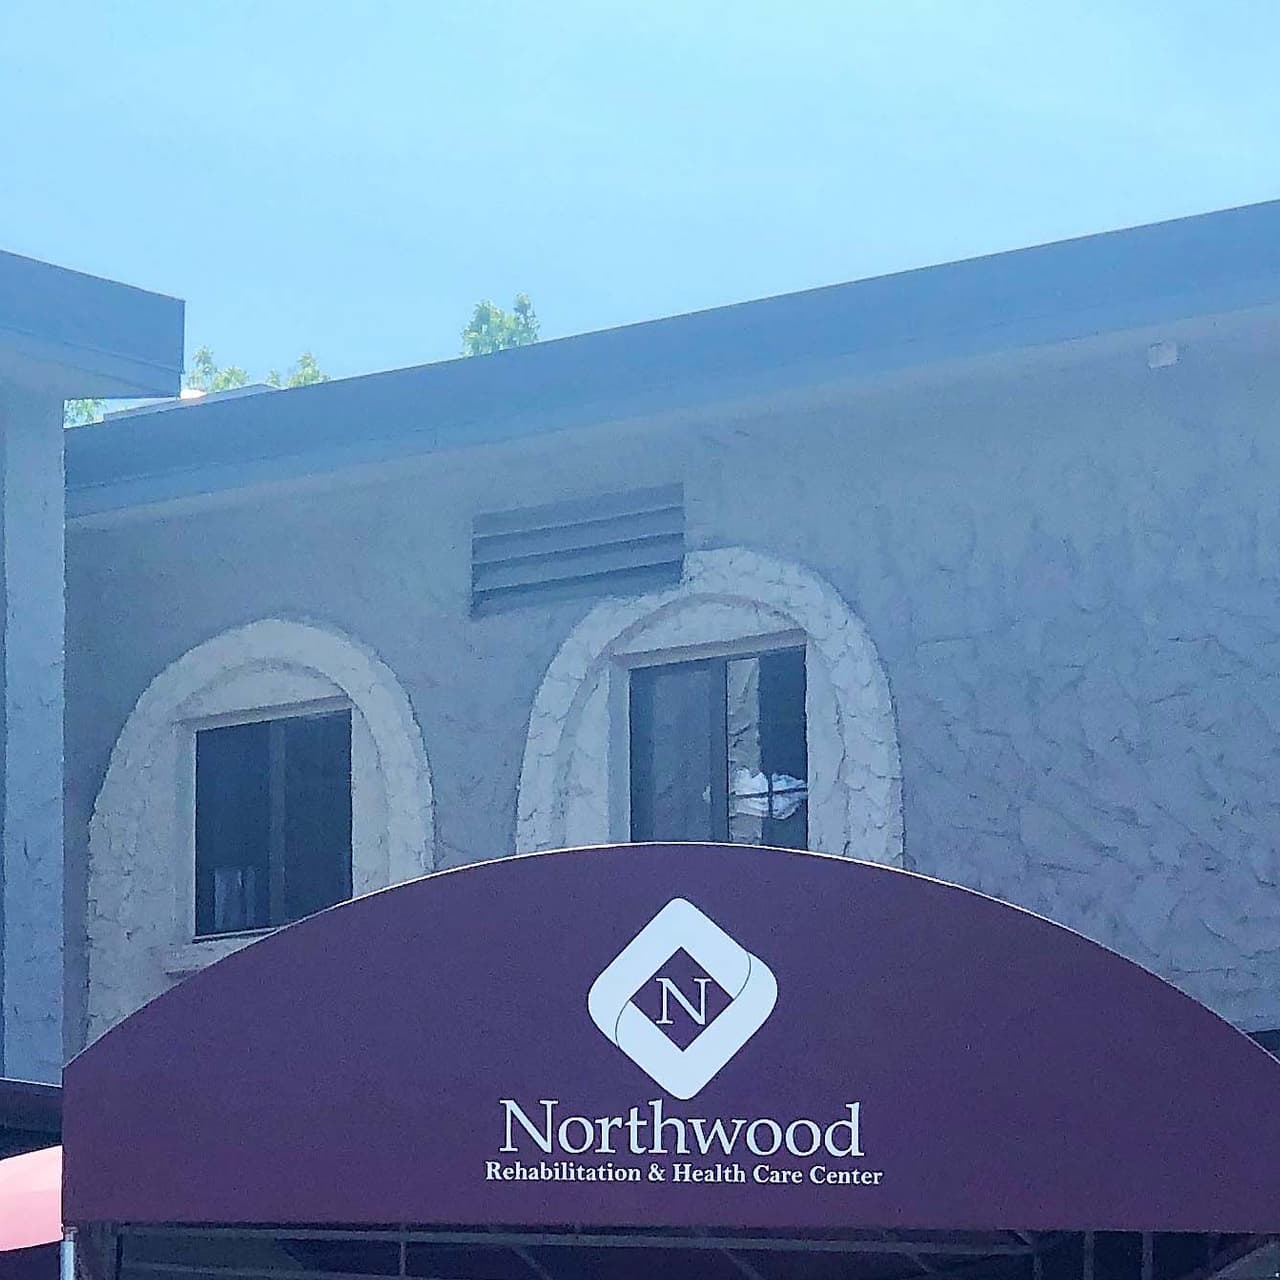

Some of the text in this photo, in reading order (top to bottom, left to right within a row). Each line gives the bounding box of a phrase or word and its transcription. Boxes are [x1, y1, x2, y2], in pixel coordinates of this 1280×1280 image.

[655, 977, 711, 1025] N
[499, 1099, 865, 1157] Northwood
[485, 1161, 883, 1186] Rehabilitation & Health Care Center
